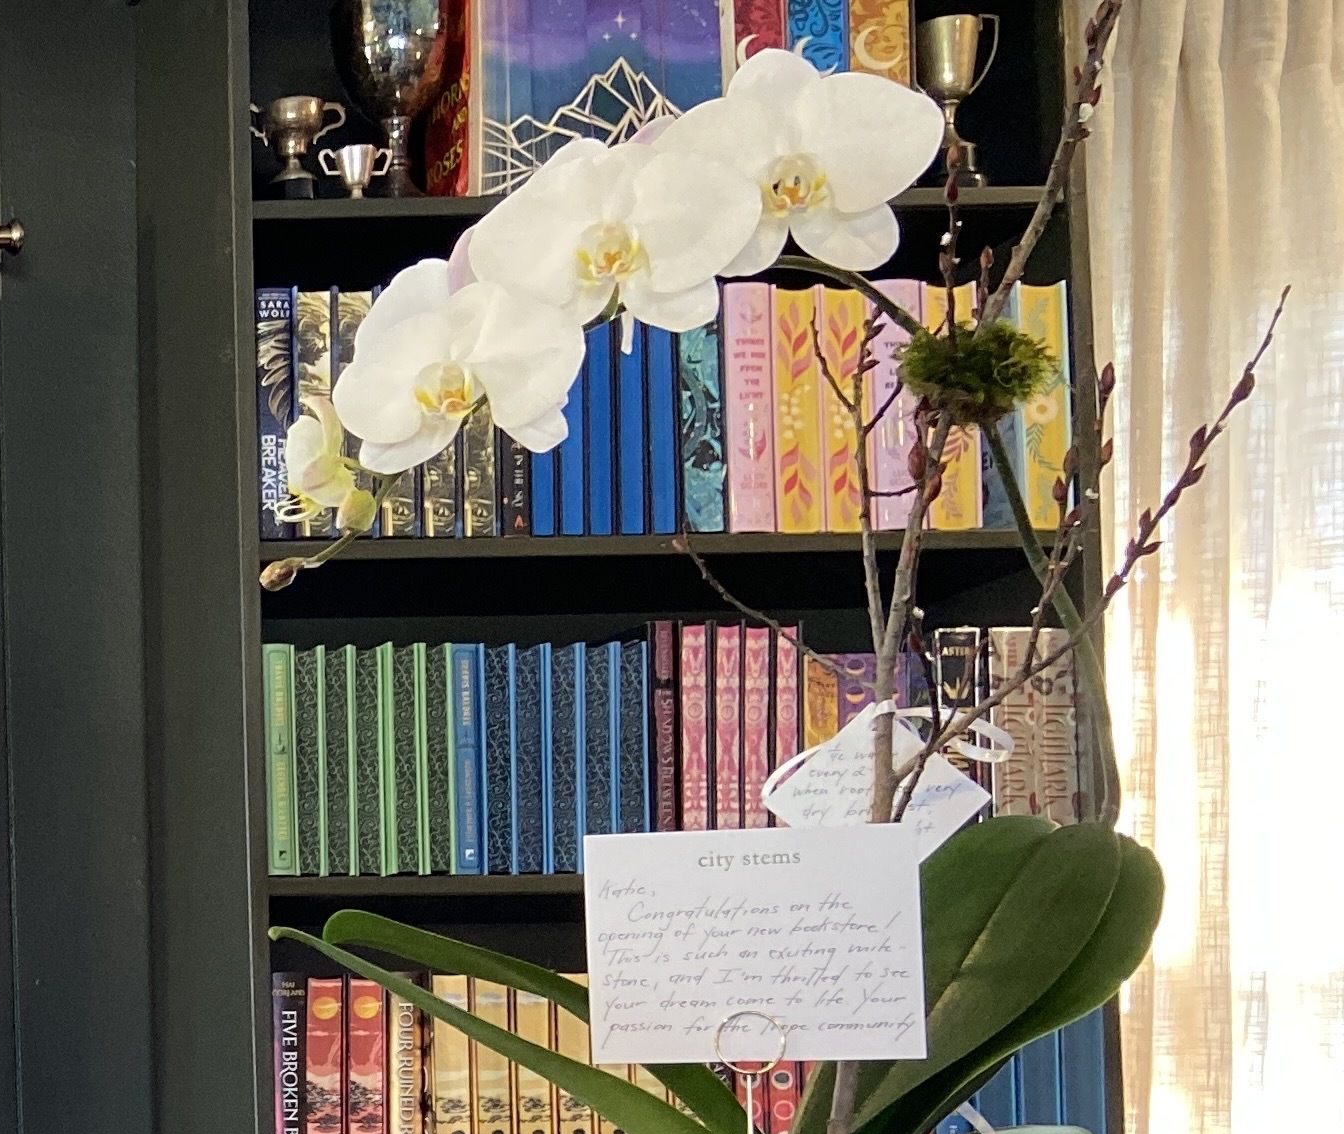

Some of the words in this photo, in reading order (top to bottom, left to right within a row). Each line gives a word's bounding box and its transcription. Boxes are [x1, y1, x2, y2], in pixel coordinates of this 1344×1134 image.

[259, 309, 291, 319] WOLF
[260, 300, 290, 310] SARA
[261, 434, 277, 512] BREAKER
[697, 851, 735, 872] city
[742, 851, 802, 866] stems
[627, 895, 780, 932] Congratulations
[789, 903, 811, 912] on
[818, 891, 854, 912] the
[597, 930, 665, 958] opening
[674, 922, 696, 941] of
[698, 928, 743, 951] your
[746, 927, 783, 937] new
[607, 948, 642, 967] This
[654, 950, 671, 963] is
[682, 943, 728, 961] such
[738, 949, 759, 959] an
[768, 941, 837, 970] exciting
[668, 966, 709, 986] and
[712, 968, 763, 985] I'm
[771, 964, 850, 987] thrilled
[854, 960, 874, 982] to
[879, 967, 910, 979] see
[272, 989, 306, 998] CORLAND
[603, 996, 648, 1022] your
[659, 990, 717, 1011] dream
[725, 997, 776, 1007] come
[785, 988, 803, 1007] to
[851, 981, 908, 1016] Your
[281, 1009, 298, 1047] FIVE
[397, 1001, 415, 1053] FOUR
[601, 1022, 673, 1050] passion
[681, 1015, 714, 1037] for
[722, 1016, 753, 1034] the
[759, 1014, 810, 1036] Trope
[817, 1012, 917, 1042] community
[279, 1051, 300, 1121] BROKEN
[398, 1056, 415, 1121] RUINED
